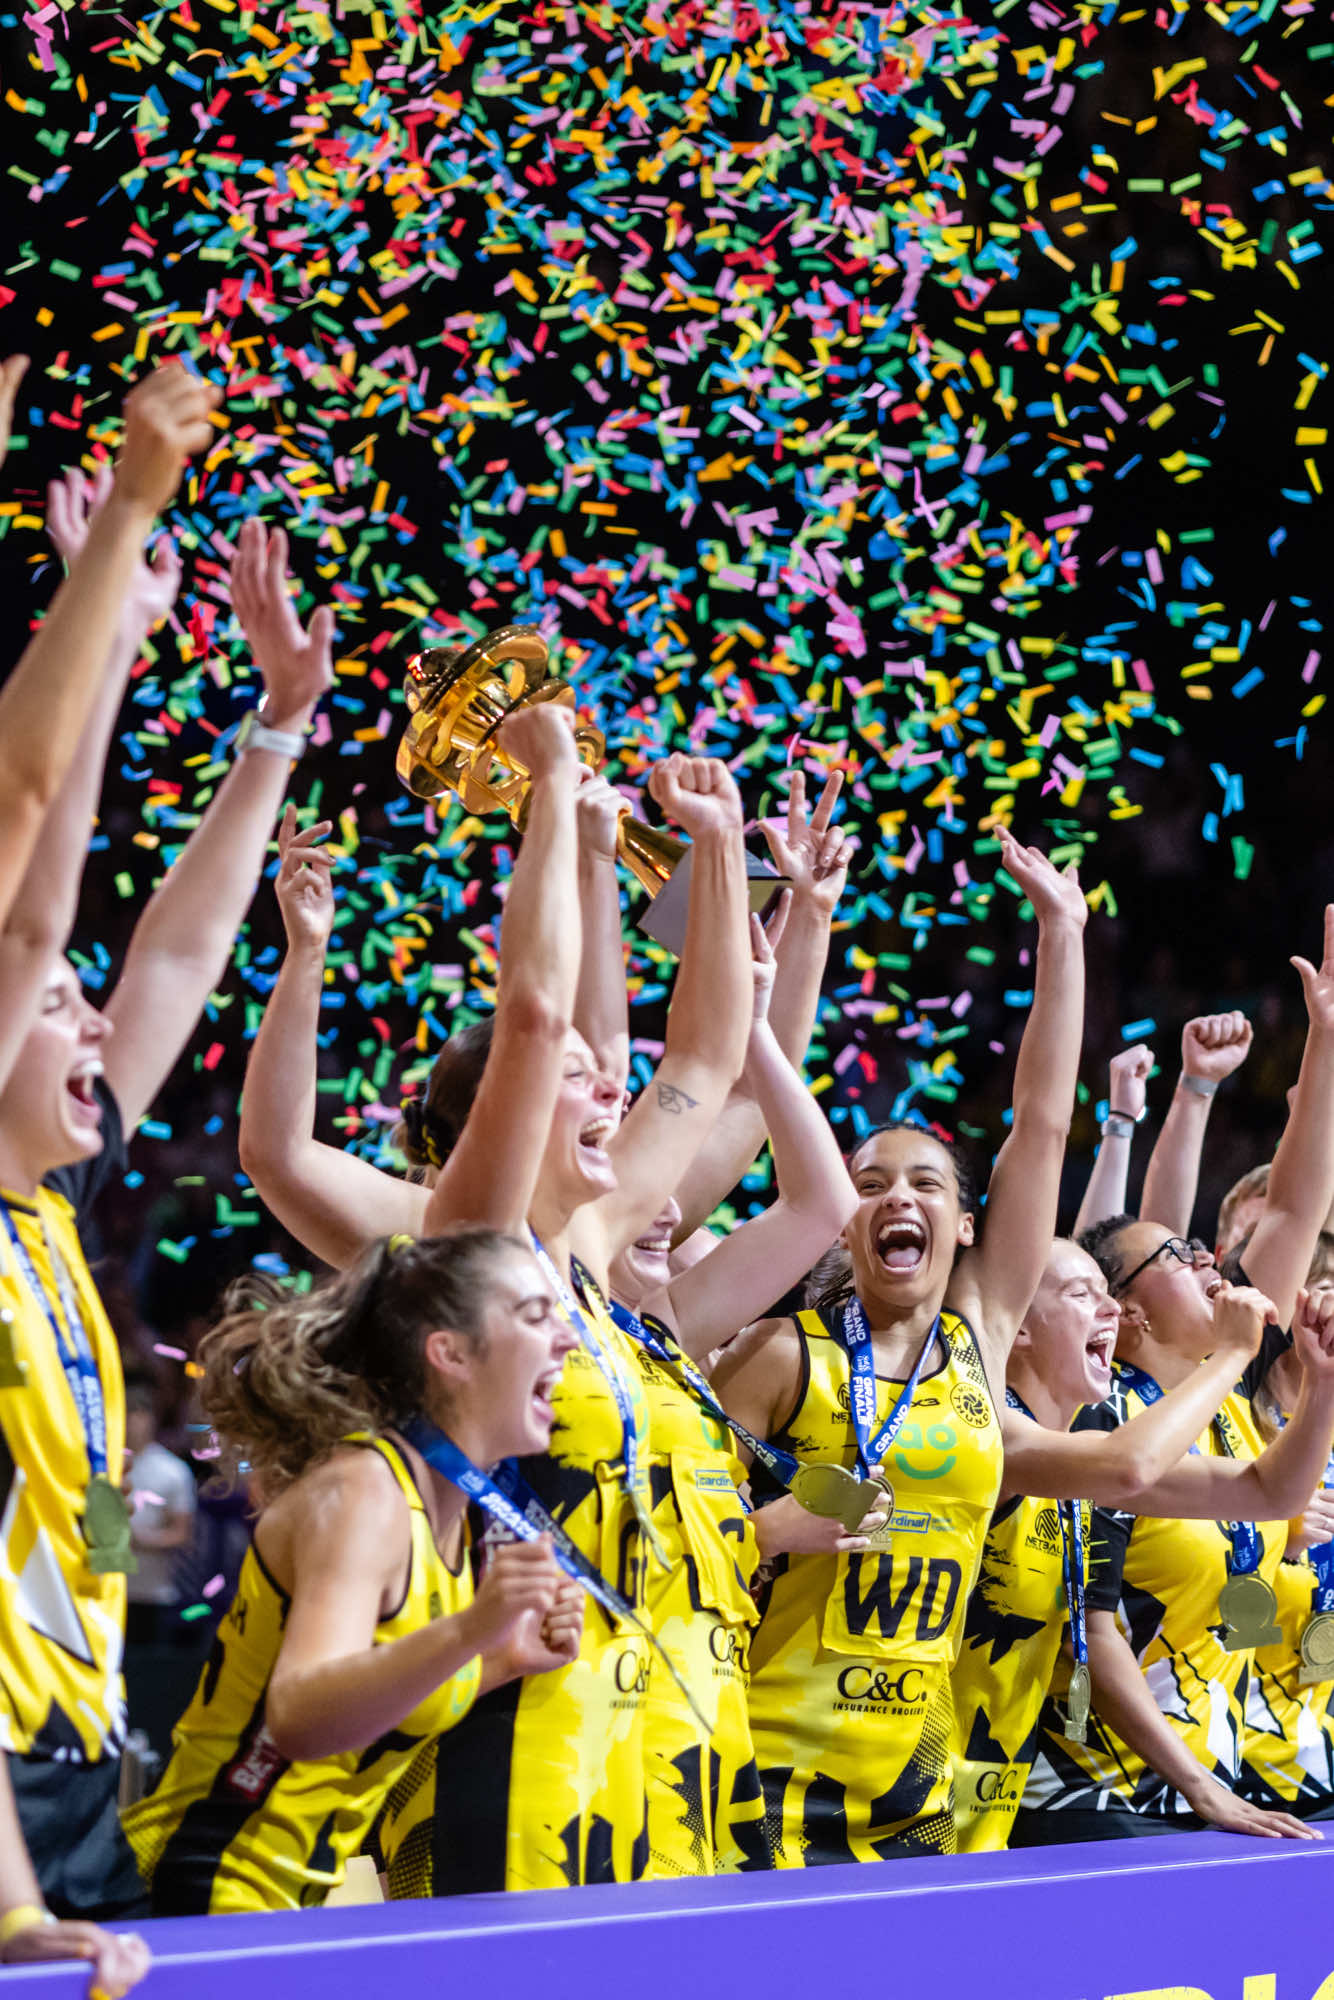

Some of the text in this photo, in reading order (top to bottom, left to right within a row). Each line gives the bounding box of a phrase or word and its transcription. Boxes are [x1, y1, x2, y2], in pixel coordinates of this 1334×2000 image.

[875, 1404, 909, 1453] GRAND
[894, 1423, 957, 1451] ao
[701, 1475, 735, 1487] cardin
[891, 1516, 926, 1528] rdinal
[1025, 1535, 1063, 1555] NETBAL
[844, 1552, 962, 1641] WD
[837, 1665, 928, 1704] C&C.
[832, 1702, 888, 1715] INSURANCE
